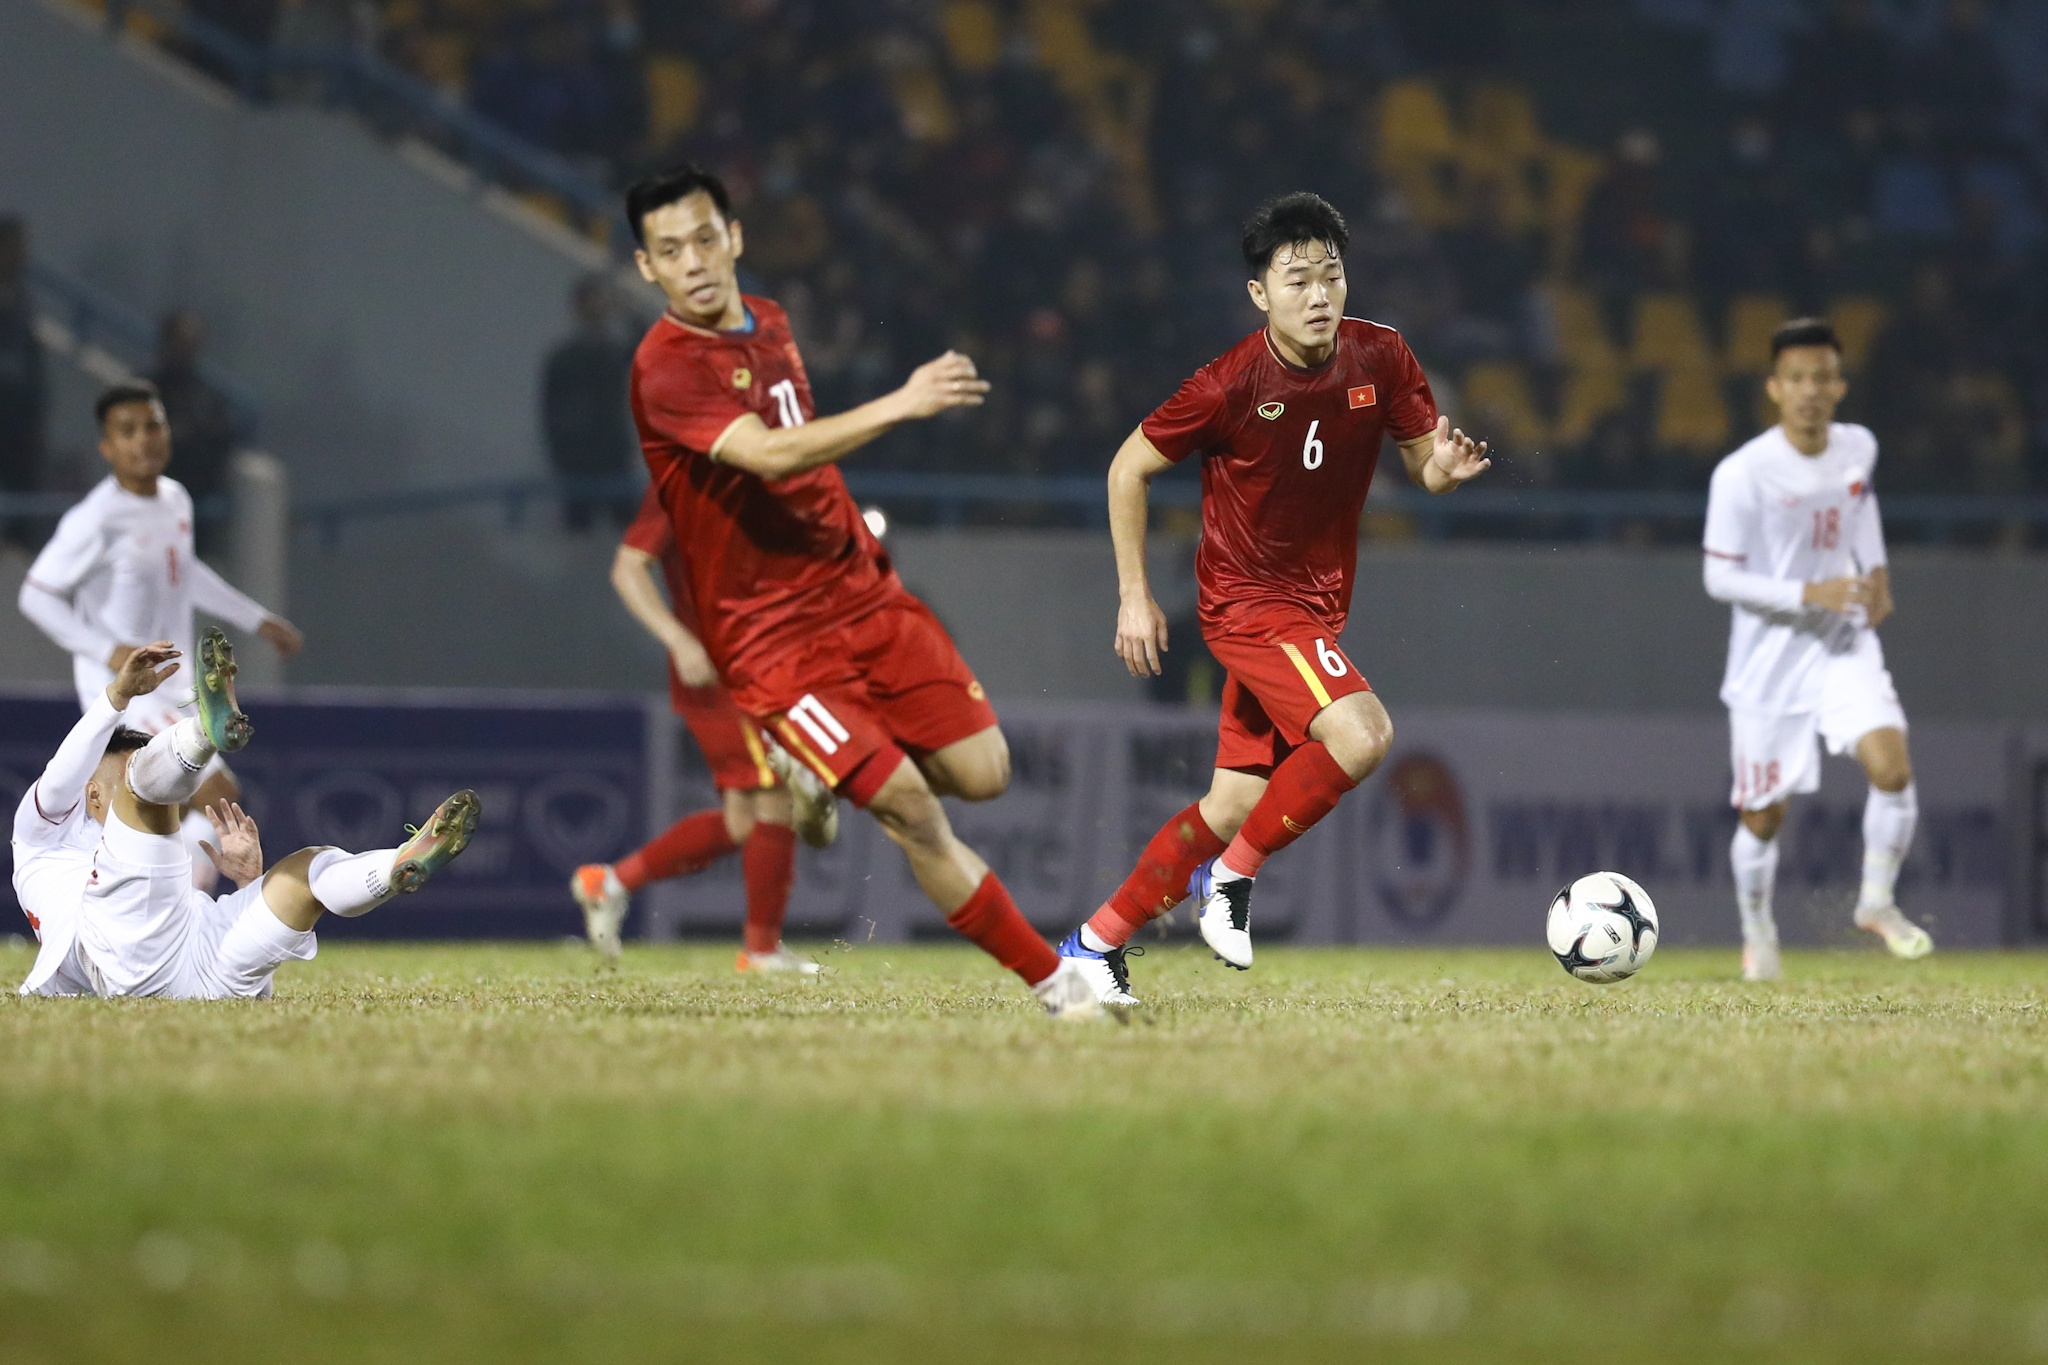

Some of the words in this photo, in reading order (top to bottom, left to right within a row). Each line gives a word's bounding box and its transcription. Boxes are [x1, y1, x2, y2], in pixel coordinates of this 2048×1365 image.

[769, 379, 804, 429] 11
[1303, 419, 1324, 470] 6
[1811, 507, 1841, 551] 18
[1315, 637, 1348, 678] 6
[787, 693, 851, 756] 11
